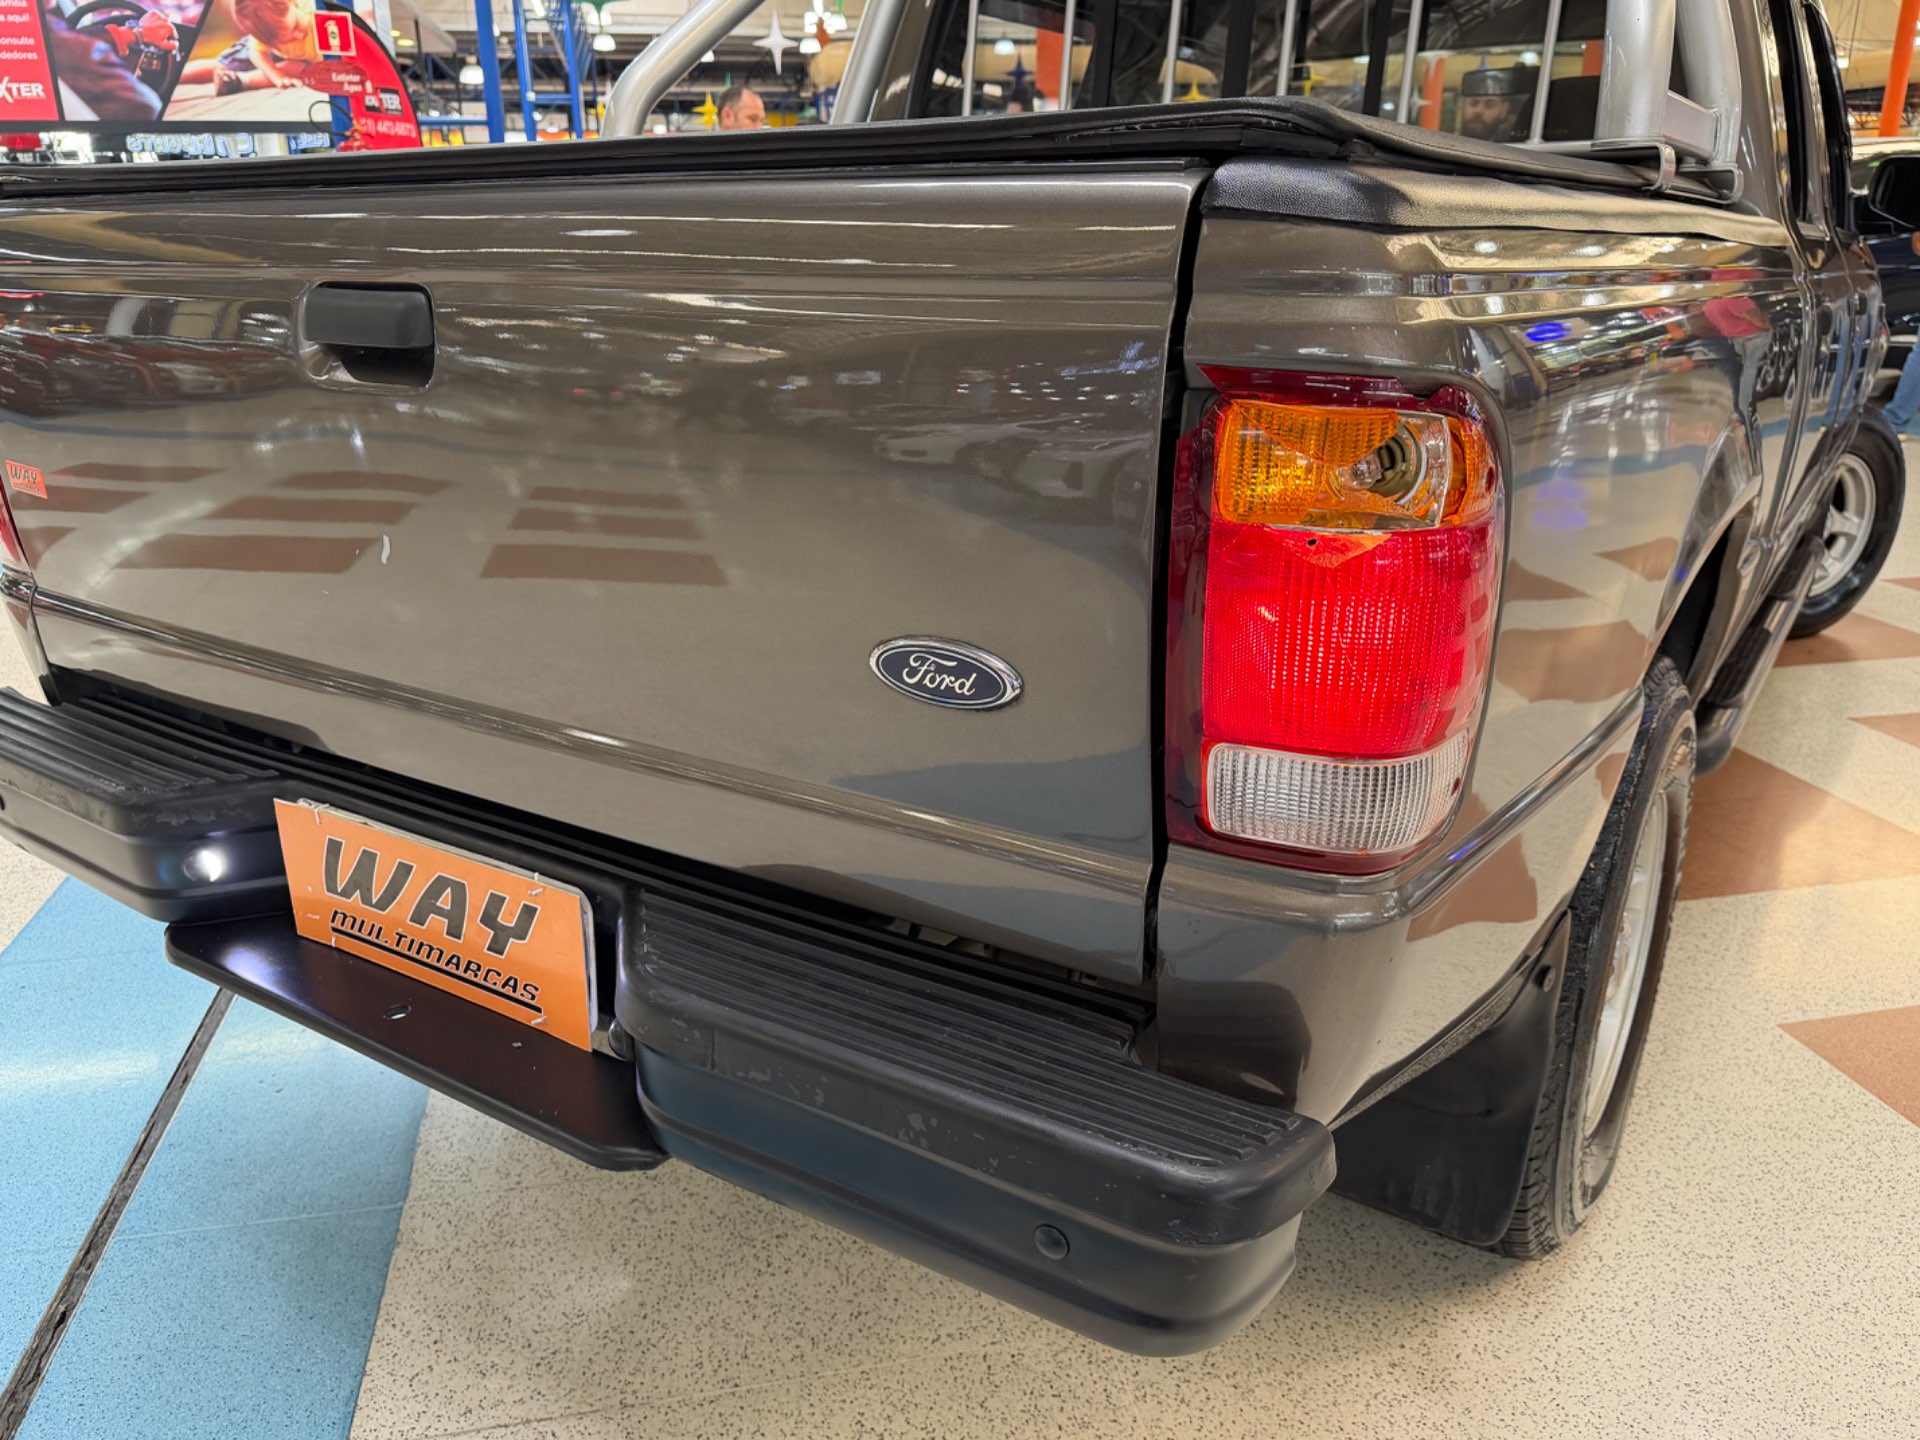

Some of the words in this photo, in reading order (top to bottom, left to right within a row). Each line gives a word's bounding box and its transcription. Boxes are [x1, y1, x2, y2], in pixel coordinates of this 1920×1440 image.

[10, 464, 37, 485] WAY
[902, 652, 977, 696] Ford
[322, 835, 541, 959] WAY
[330, 909, 541, 1002] MULTIMARCAS
